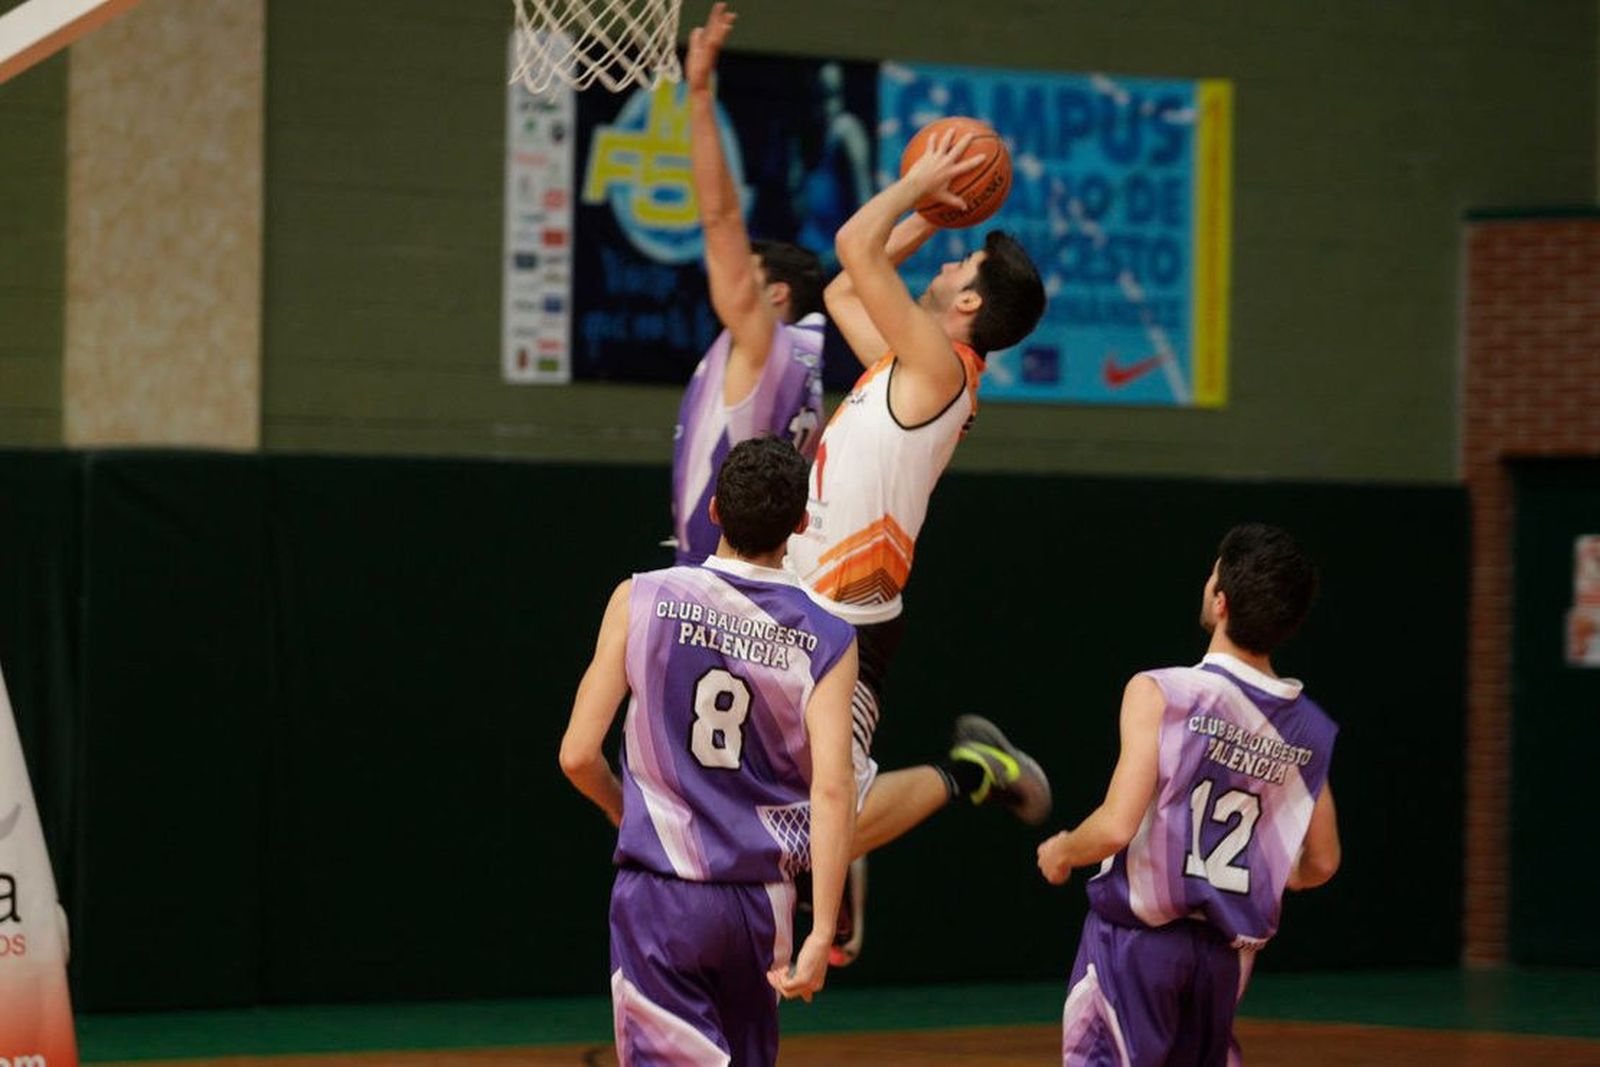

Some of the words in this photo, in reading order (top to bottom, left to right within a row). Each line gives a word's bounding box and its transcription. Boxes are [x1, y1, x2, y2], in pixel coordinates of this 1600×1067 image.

[656, 600, 703, 622] CLUB
[707, 607, 819, 652] BALONCESTO
[678, 623, 790, 670] PALENCIA
[690, 668, 753, 771] 8
[1188, 715, 1227, 737] CLUB
[1226, 724, 1313, 766] BALONCESTO
[1206, 738, 1289, 785] PALENCIA
[1183, 779, 1263, 894] 12
